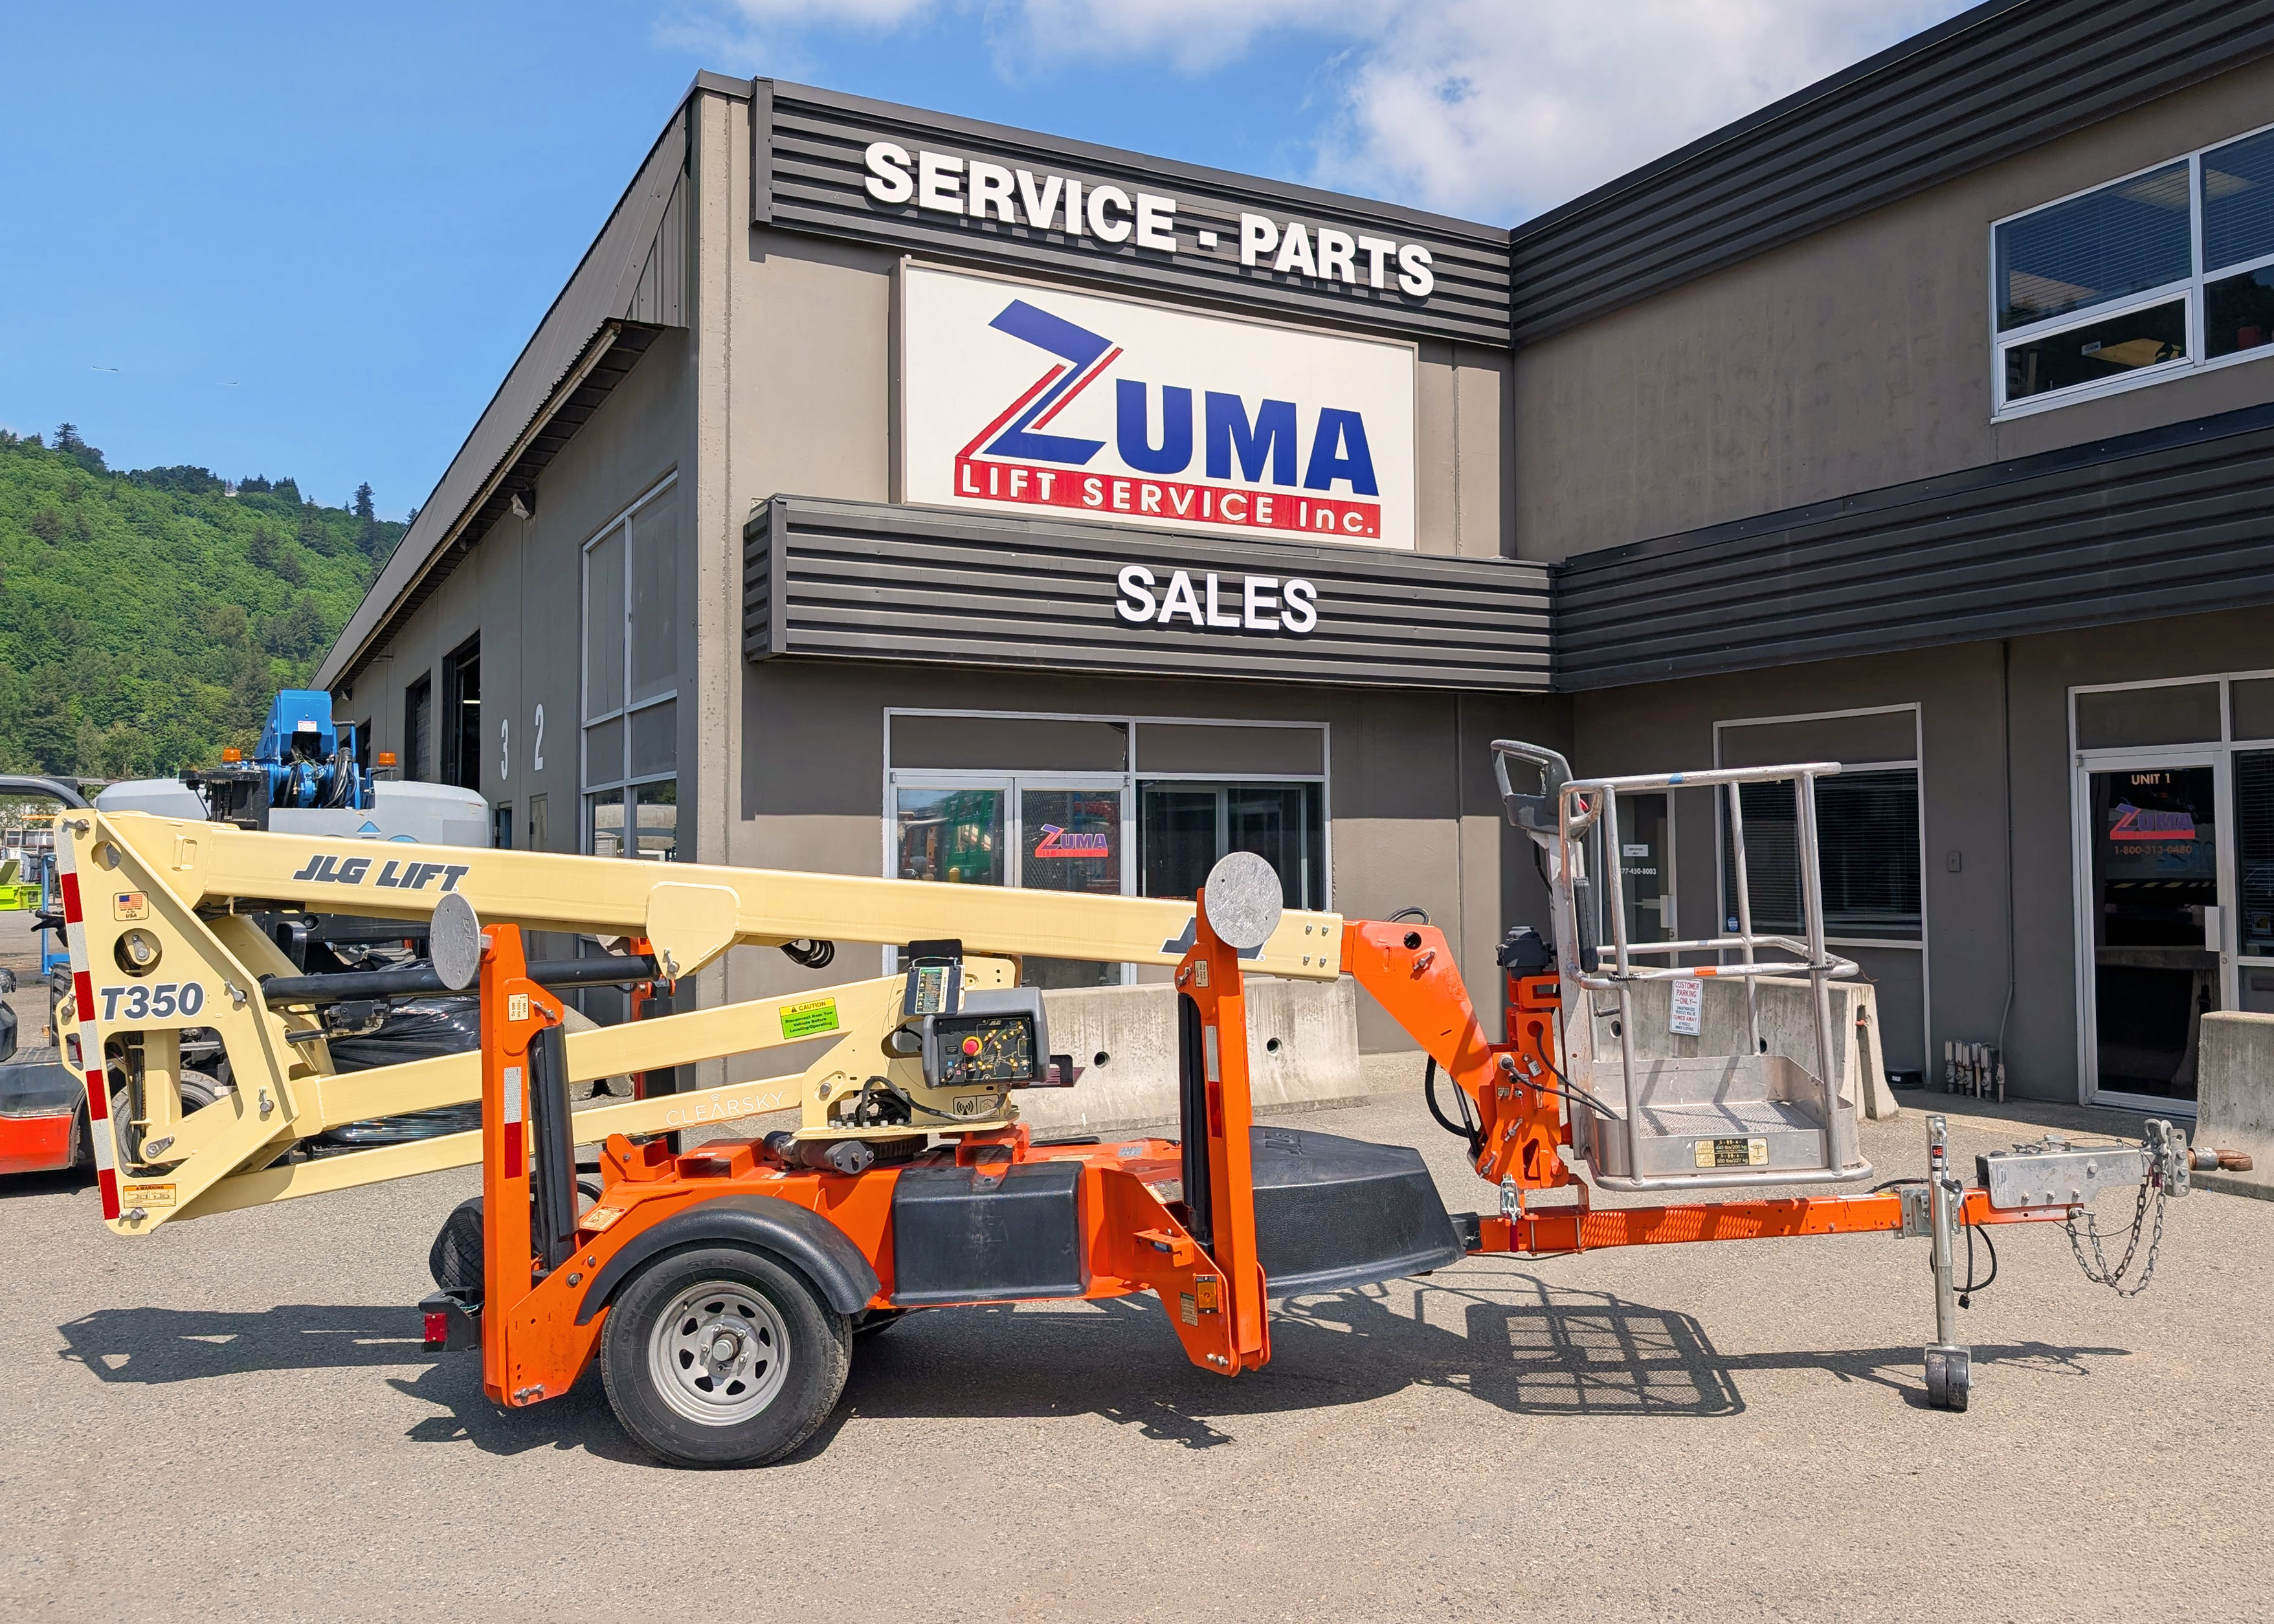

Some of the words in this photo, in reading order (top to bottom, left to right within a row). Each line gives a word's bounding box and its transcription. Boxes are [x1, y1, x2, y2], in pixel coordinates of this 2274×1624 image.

[865, 142, 1177, 252] SERVICE
[1240, 212, 1434, 296] PARTS
[955, 299, 1379, 496] ZUMA
[962, 464, 1056, 501] LIFT
[1083, 477, 1273, 524] SERVICE
[1300, 497, 1374, 535] Inc.
[1116, 565, 1317, 633] SALES
[500, 718, 509, 781] 3
[535, 704, 544, 770] 2
[2131, 773, 2161, 785] UNIT
[2165, 773, 2170, 784] 1
[2110, 803, 2195, 832] ZUMA
[1036, 823, 1108, 849] ZUMA
[2114, 845, 2193, 855] 1-800-313-0480
[291, 854, 374, 885] JLG
[373, 860, 471, 893] LIFT
[100, 981, 205, 1021] T350
[1675, 981, 1700, 990] CUSTOMER
[1677, 989, 1697, 997] PARKING
[785, 1015, 811, 1023] Disconnect
[798, 1001, 826, 1011] CAUTION
[666, 1091, 784, 1126] CLEARSKY
